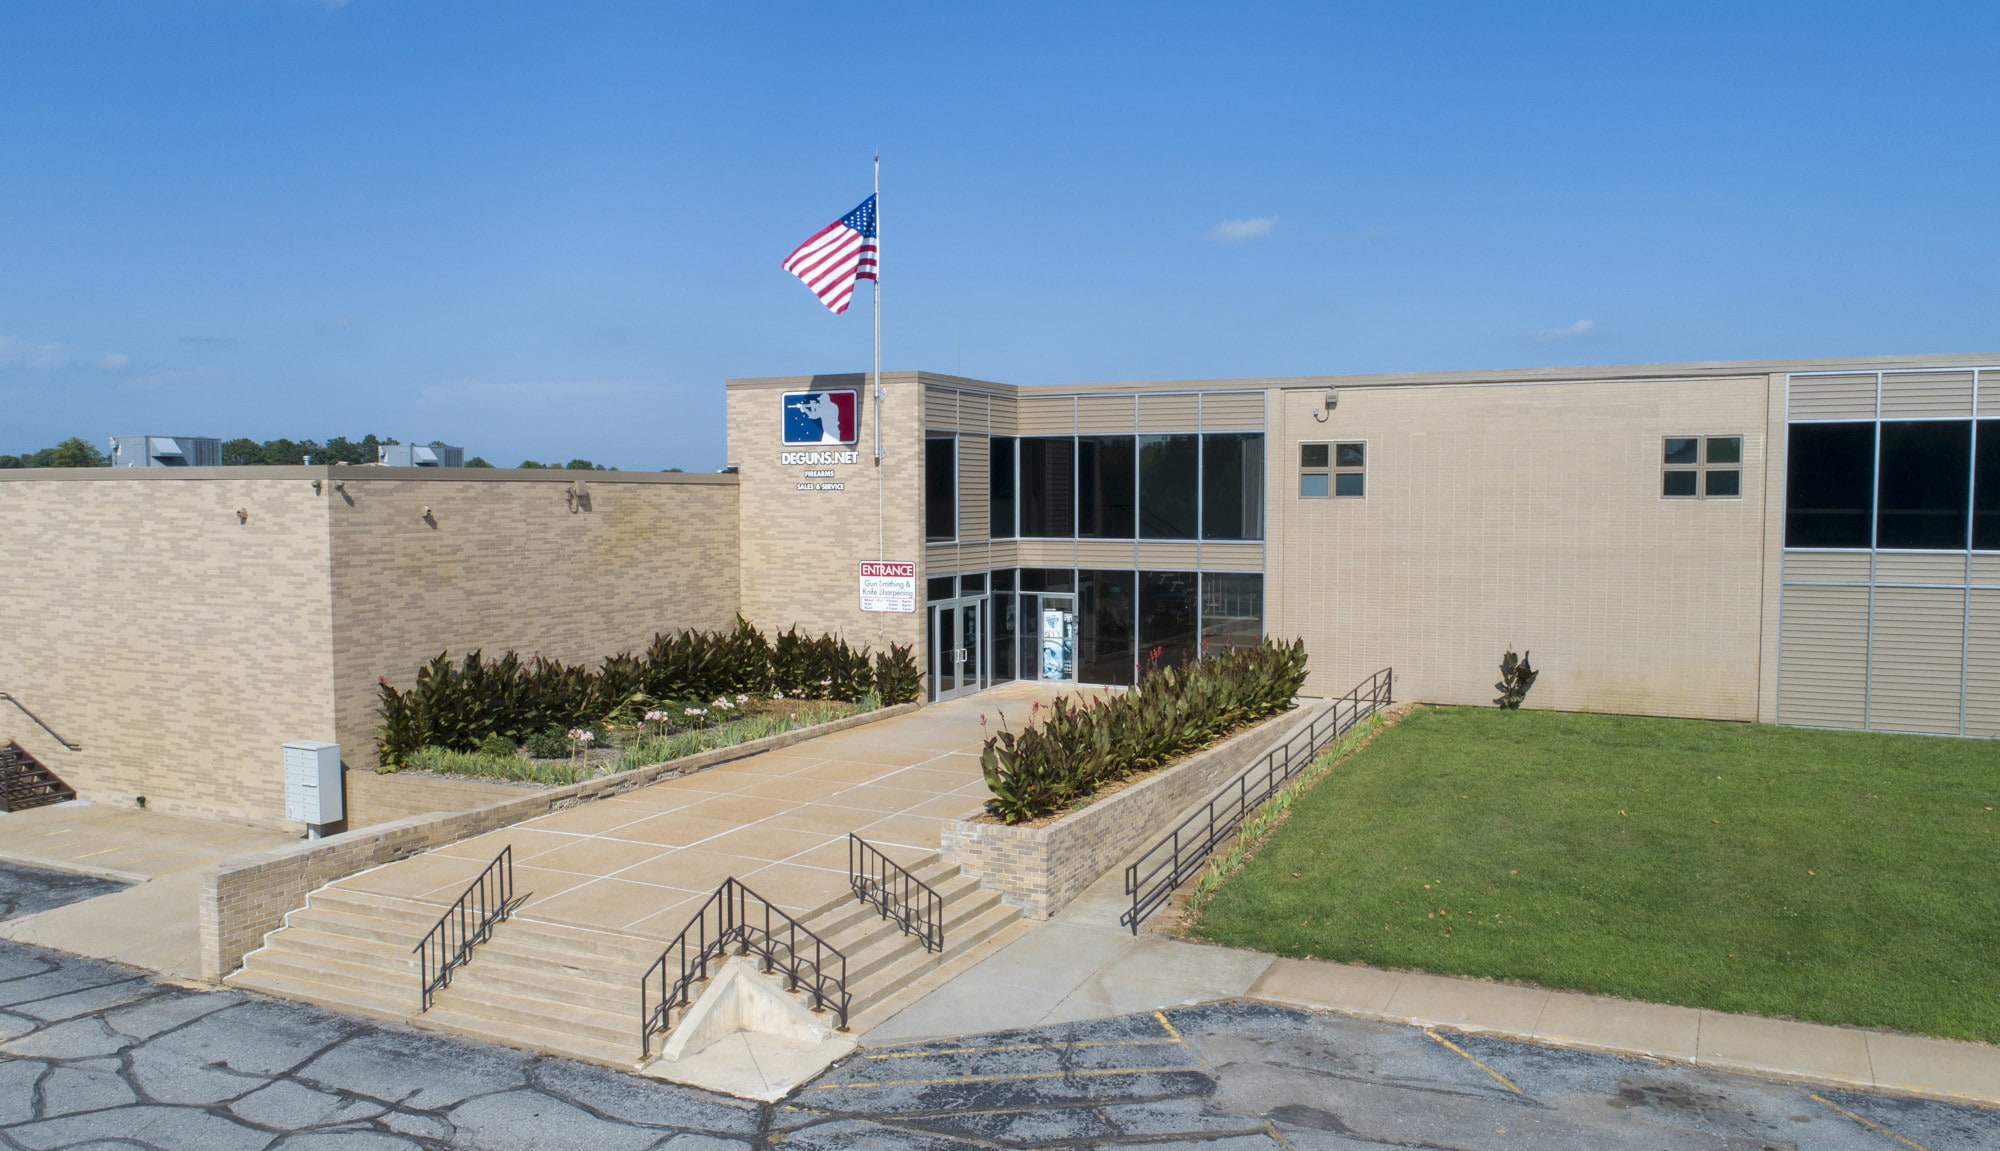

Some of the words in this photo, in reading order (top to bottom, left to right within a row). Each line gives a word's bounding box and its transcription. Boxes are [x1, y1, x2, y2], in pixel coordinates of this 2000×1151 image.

[781, 451, 859, 465] DEGUNS.NET
[804, 470, 835, 478] FIREARMS
[862, 565, 913, 576] ENTRANCE
[879, 580, 904, 589] Smithing
[862, 588, 877, 596] Knife
[879, 588, 913, 598] Sharpening
